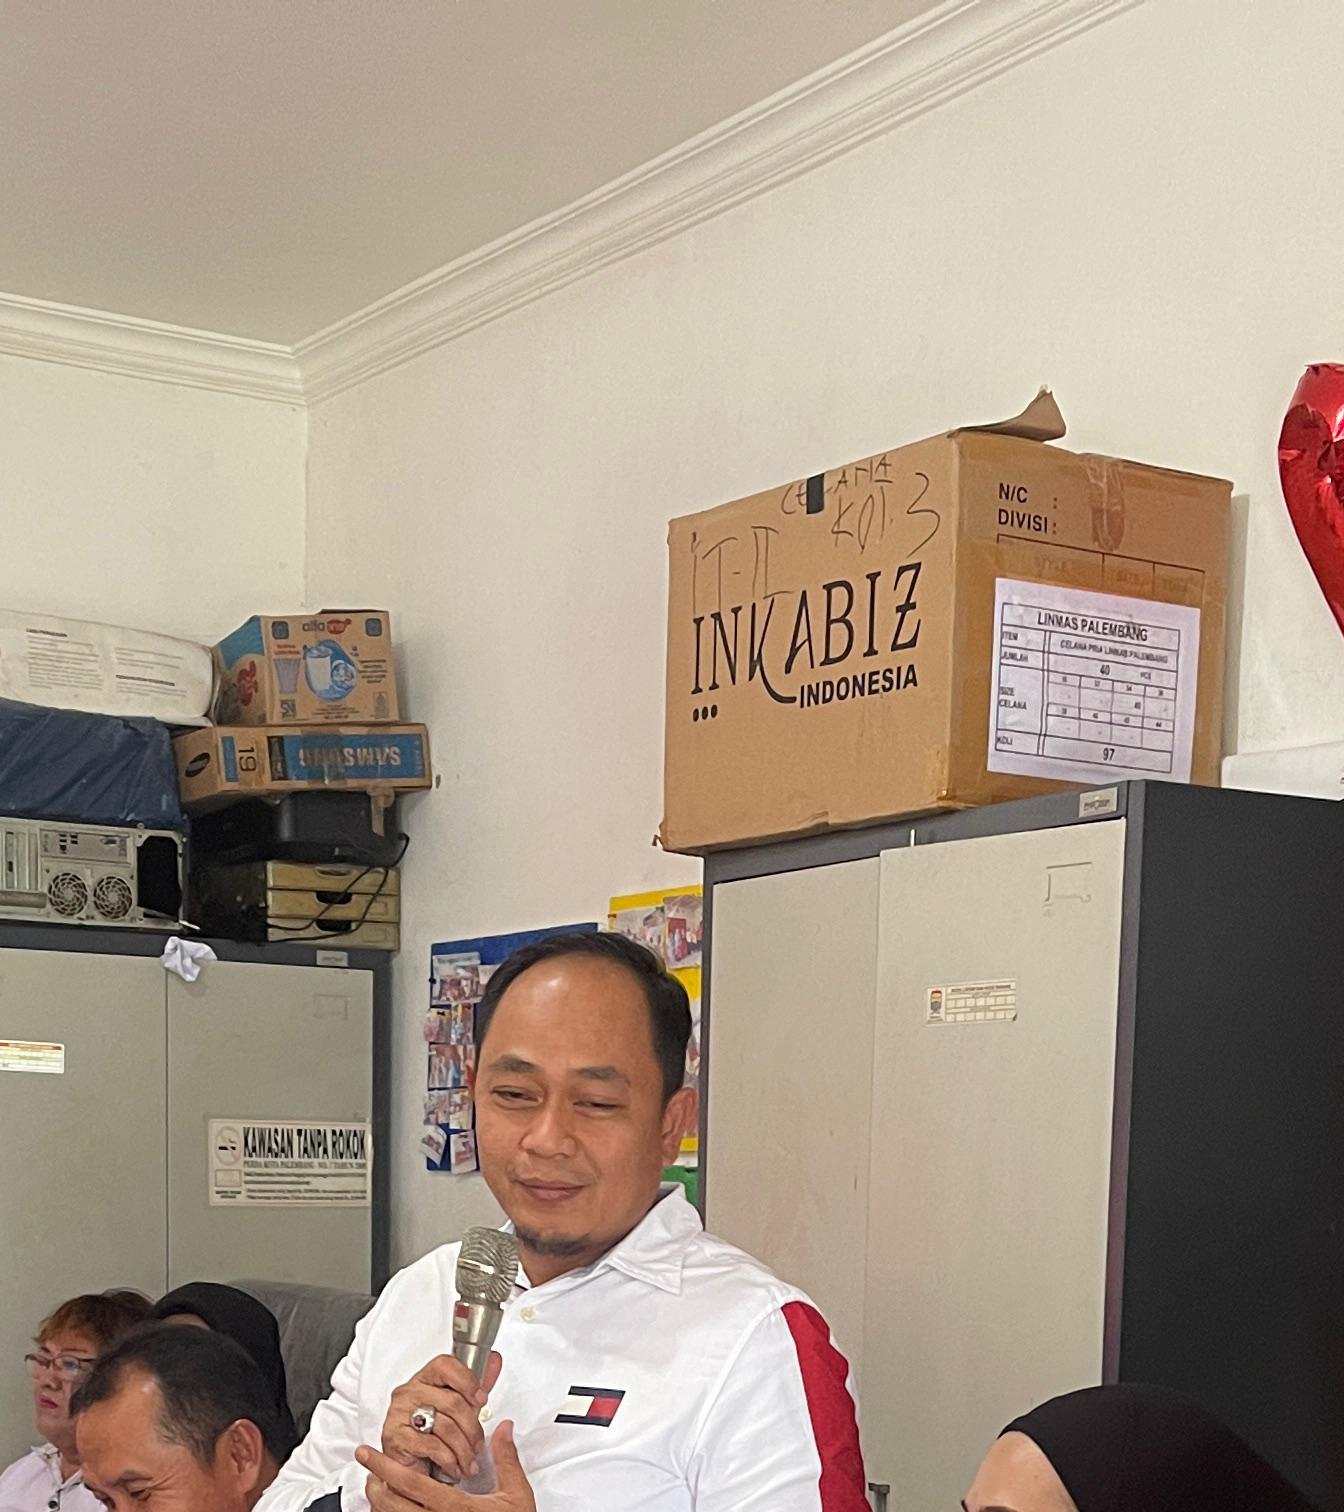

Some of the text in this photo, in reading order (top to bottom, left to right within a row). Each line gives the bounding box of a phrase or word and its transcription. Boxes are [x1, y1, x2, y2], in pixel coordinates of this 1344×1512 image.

[998, 482, 1028, 503] N/C
[998, 508, 1048, 533] DIVISI
[691, 562, 922, 704] INKABIZ
[1037, 611, 1148, 642] LINMAS PALEMBANG
[800, 664, 918, 708] INDONESIA
[1103, 748, 1116, 761] 97
[243, 1127, 294, 1158] KAWASAN
[297, 1128, 329, 1159] TANPA
